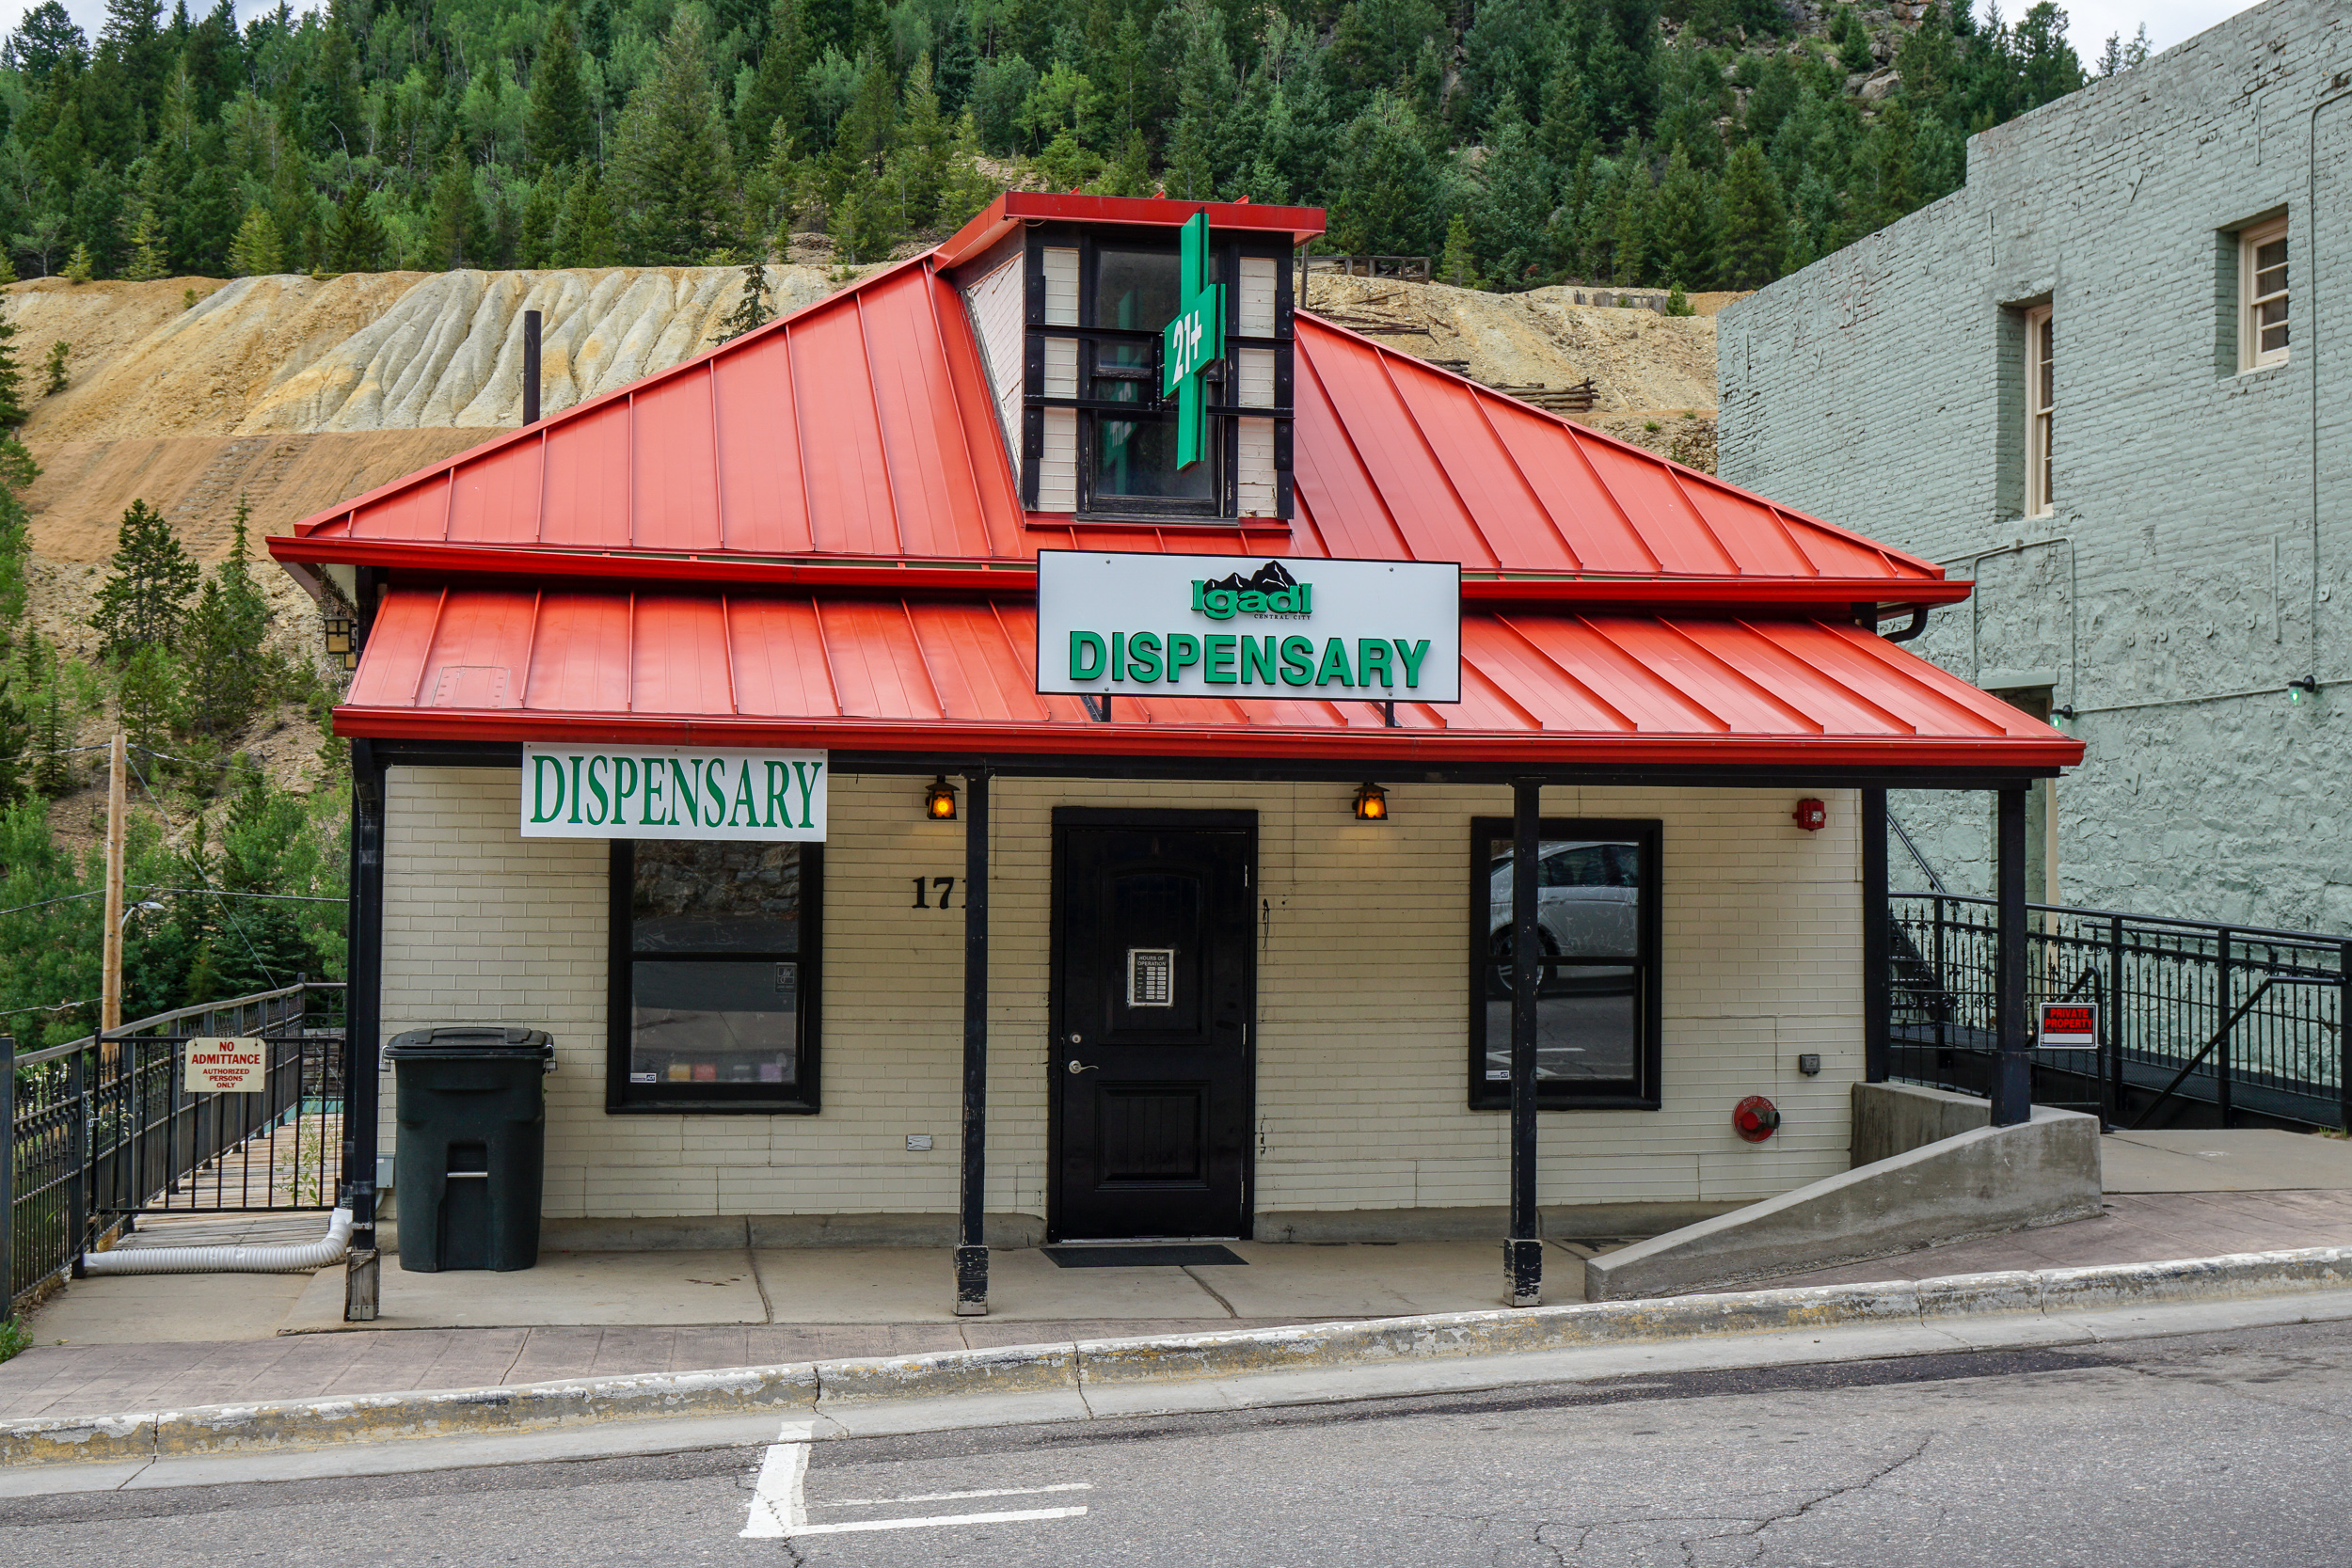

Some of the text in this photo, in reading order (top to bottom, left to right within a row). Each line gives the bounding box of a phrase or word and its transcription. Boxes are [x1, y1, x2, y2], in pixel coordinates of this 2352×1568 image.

[1172, 309, 1201, 385] 21+
[1069, 630, 1431, 688] DISPENSARY
[530, 754, 823, 829] DISPENSARY
[912, 876, 966, 910] 17
[2050, 1008, 2089, 1018] PRIVATE
[2044, 1019, 2093, 1028] PROPERTY
[219, 1041, 234, 1052] NO
[191, 1054, 261, 1065] ADMITTANCE
[1742, 1097, 1757, 1106] AUTO
